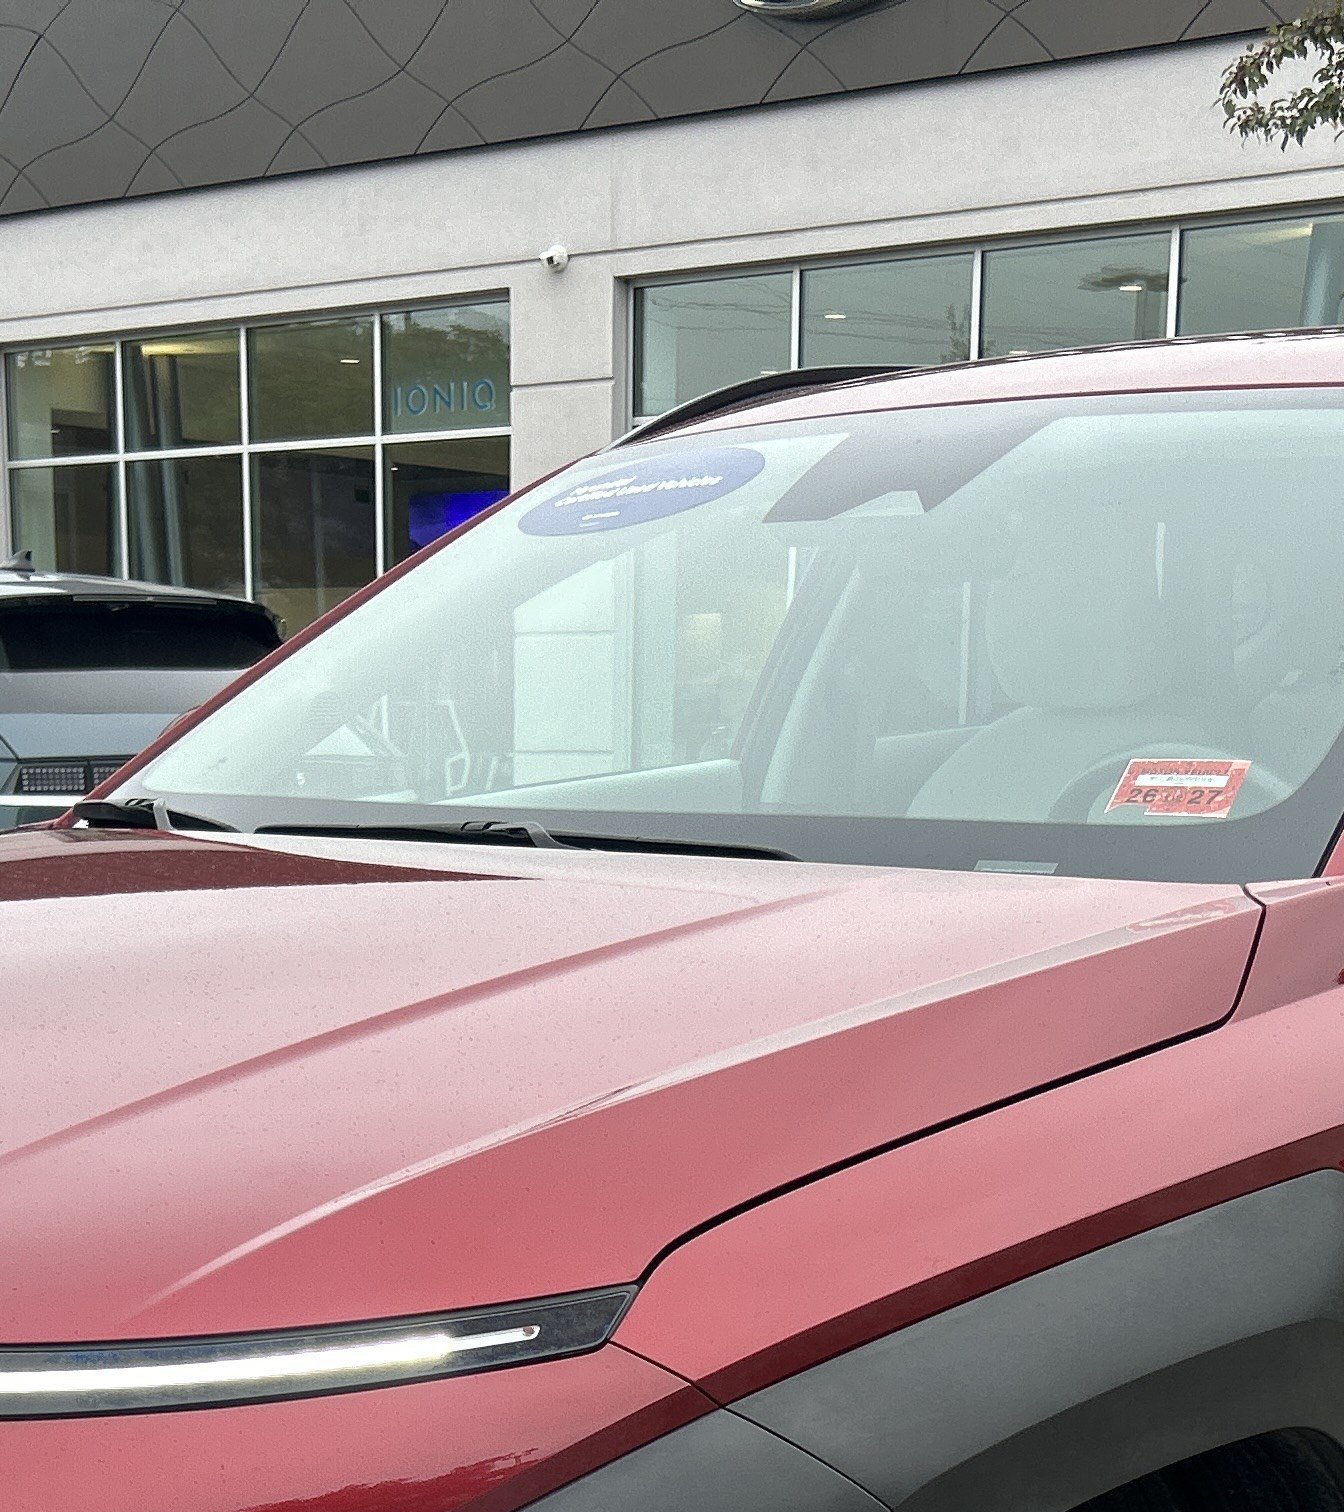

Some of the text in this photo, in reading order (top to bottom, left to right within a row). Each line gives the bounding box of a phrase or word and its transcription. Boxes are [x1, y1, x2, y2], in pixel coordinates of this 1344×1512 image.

[393, 379, 496, 417] IONIQ
[1124, 788, 1159, 803] 26
[1186, 789, 1224, 805] 27
